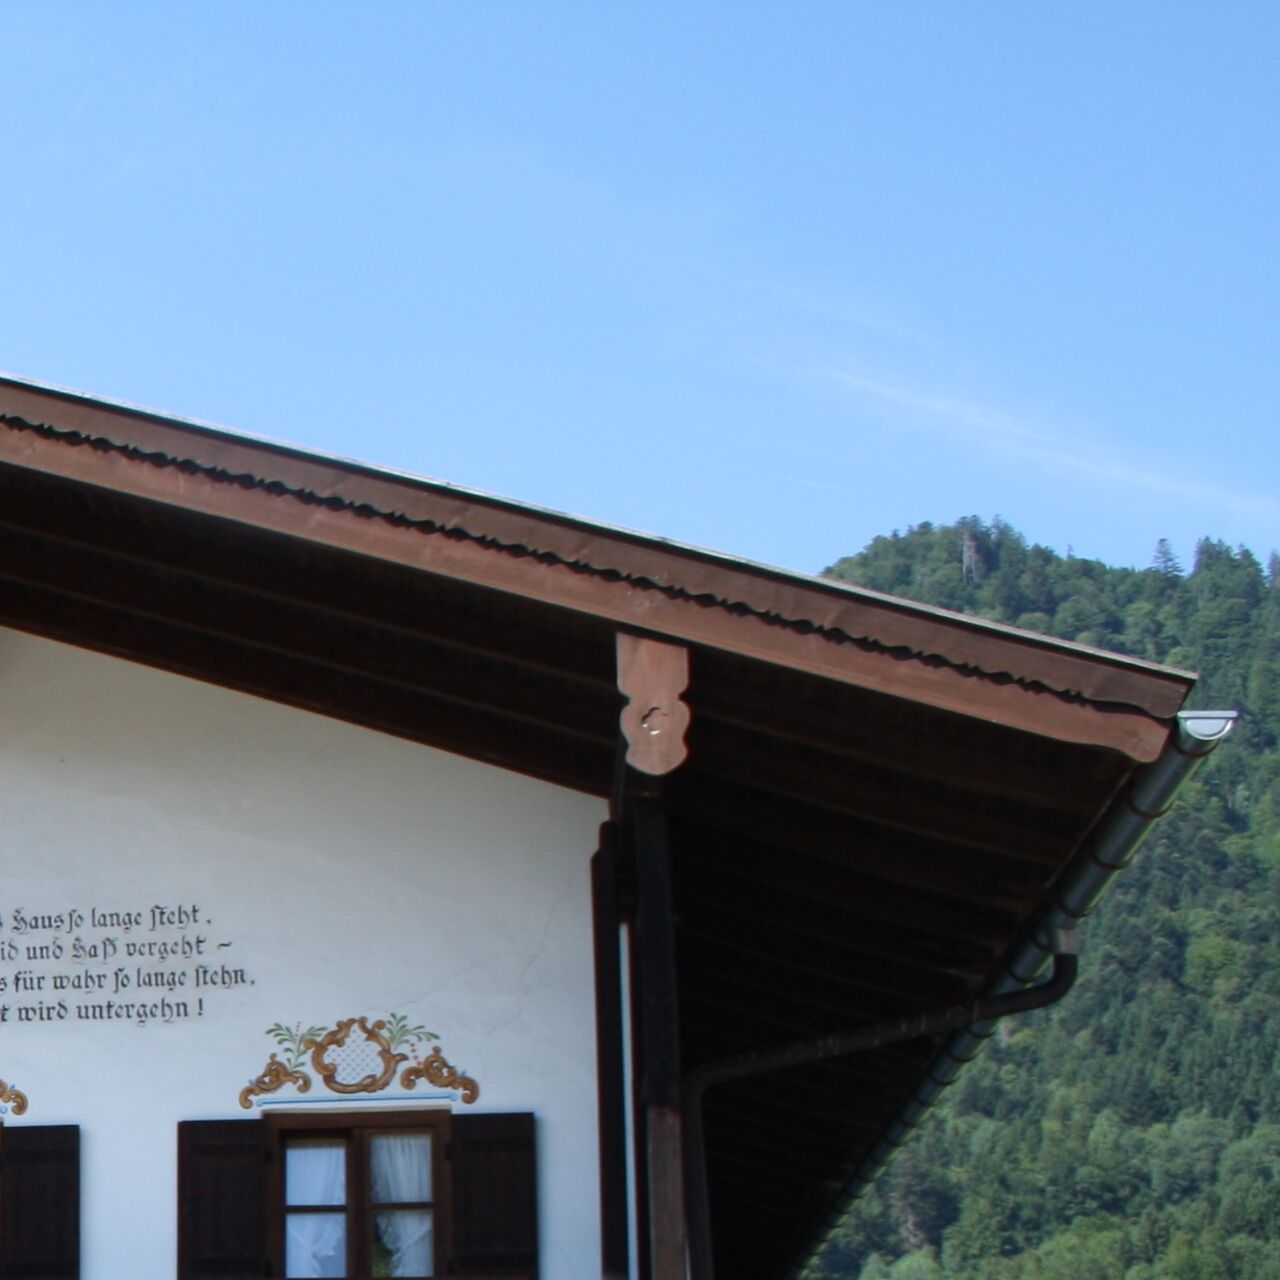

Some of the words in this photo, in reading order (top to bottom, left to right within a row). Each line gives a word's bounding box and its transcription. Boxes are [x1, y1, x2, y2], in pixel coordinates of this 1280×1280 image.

[12, 908, 64, 934] Haus
[92, 907, 142, 932] lange
[26, 937, 63, 959] und
[125, 935, 206, 961] vergeht
[14, 970, 45, 992] für
[53, 969, 107, 994] wahr
[137, 967, 187, 991] lange
[18, 1000, 68, 1022] wird
